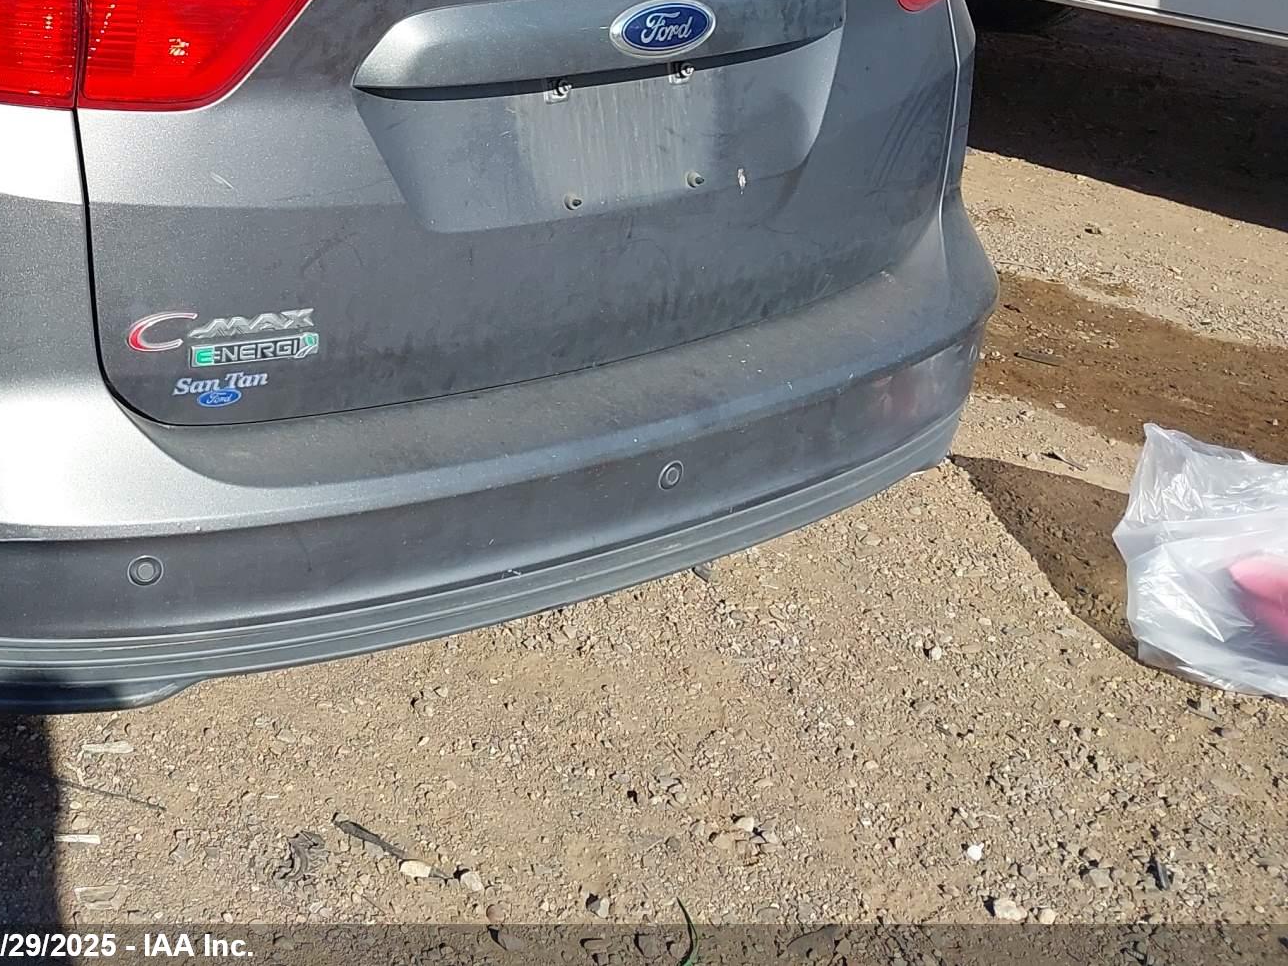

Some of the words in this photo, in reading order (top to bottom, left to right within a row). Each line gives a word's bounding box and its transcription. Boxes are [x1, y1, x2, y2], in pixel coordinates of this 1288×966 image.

[640, 11, 693, 44] Ford
[172, 377, 221, 396] San
[224, 372, 269, 389] Tan
